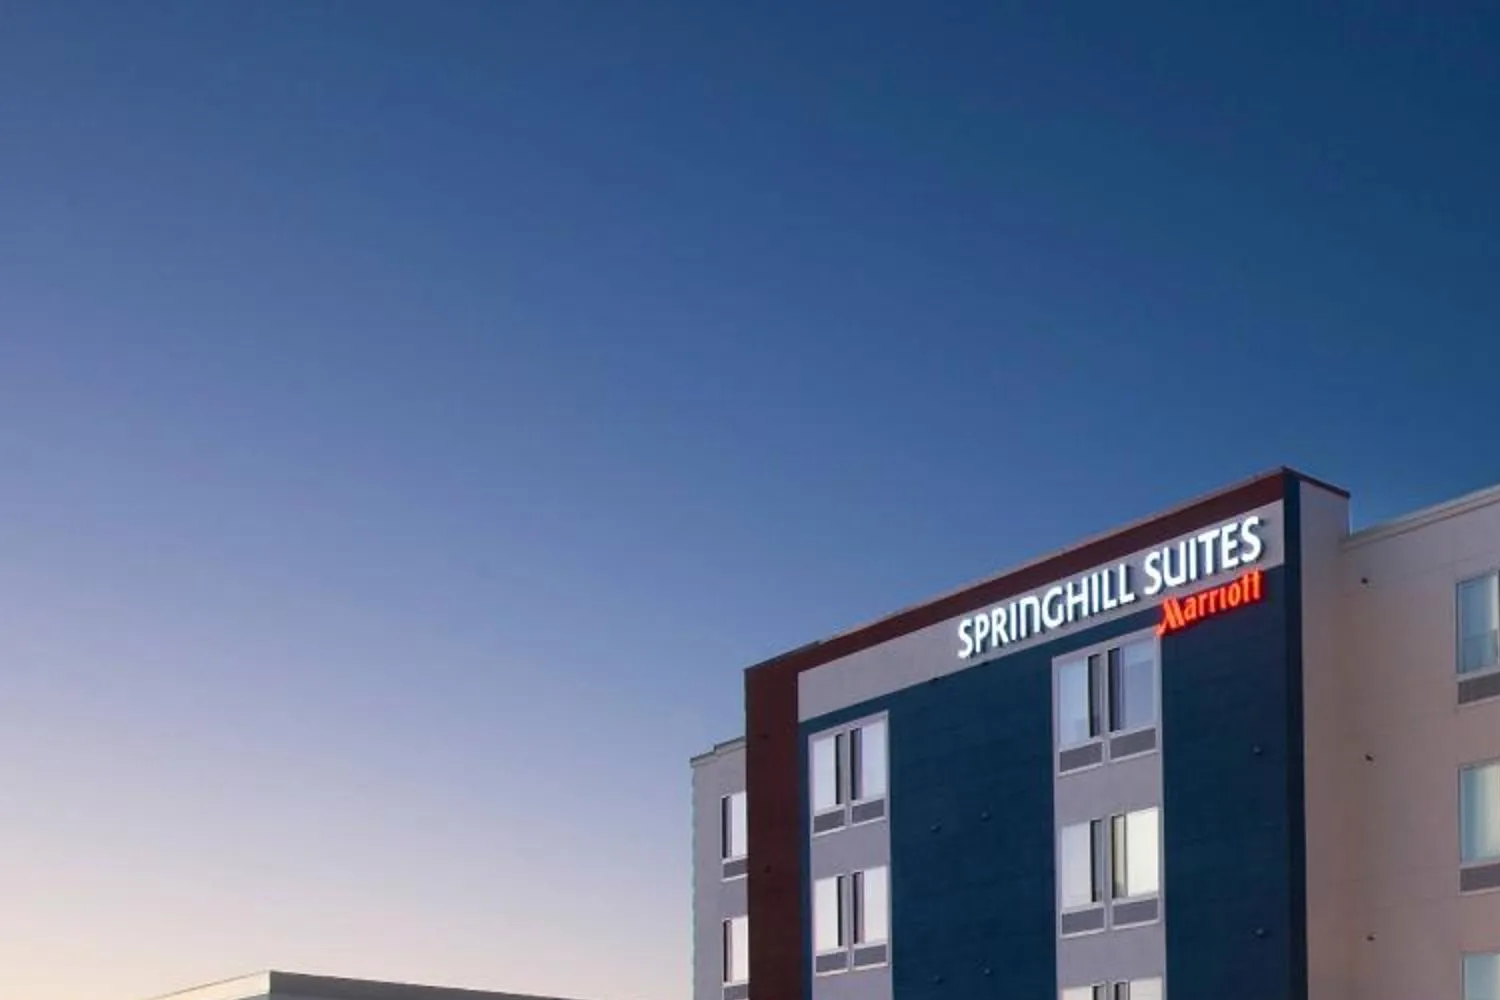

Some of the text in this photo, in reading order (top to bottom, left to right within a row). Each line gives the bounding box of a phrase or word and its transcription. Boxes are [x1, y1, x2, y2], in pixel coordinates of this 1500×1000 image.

[957, 515, 1262, 660] SPRINGHILL SUITES
[1156, 569, 1265, 637] Marriott
